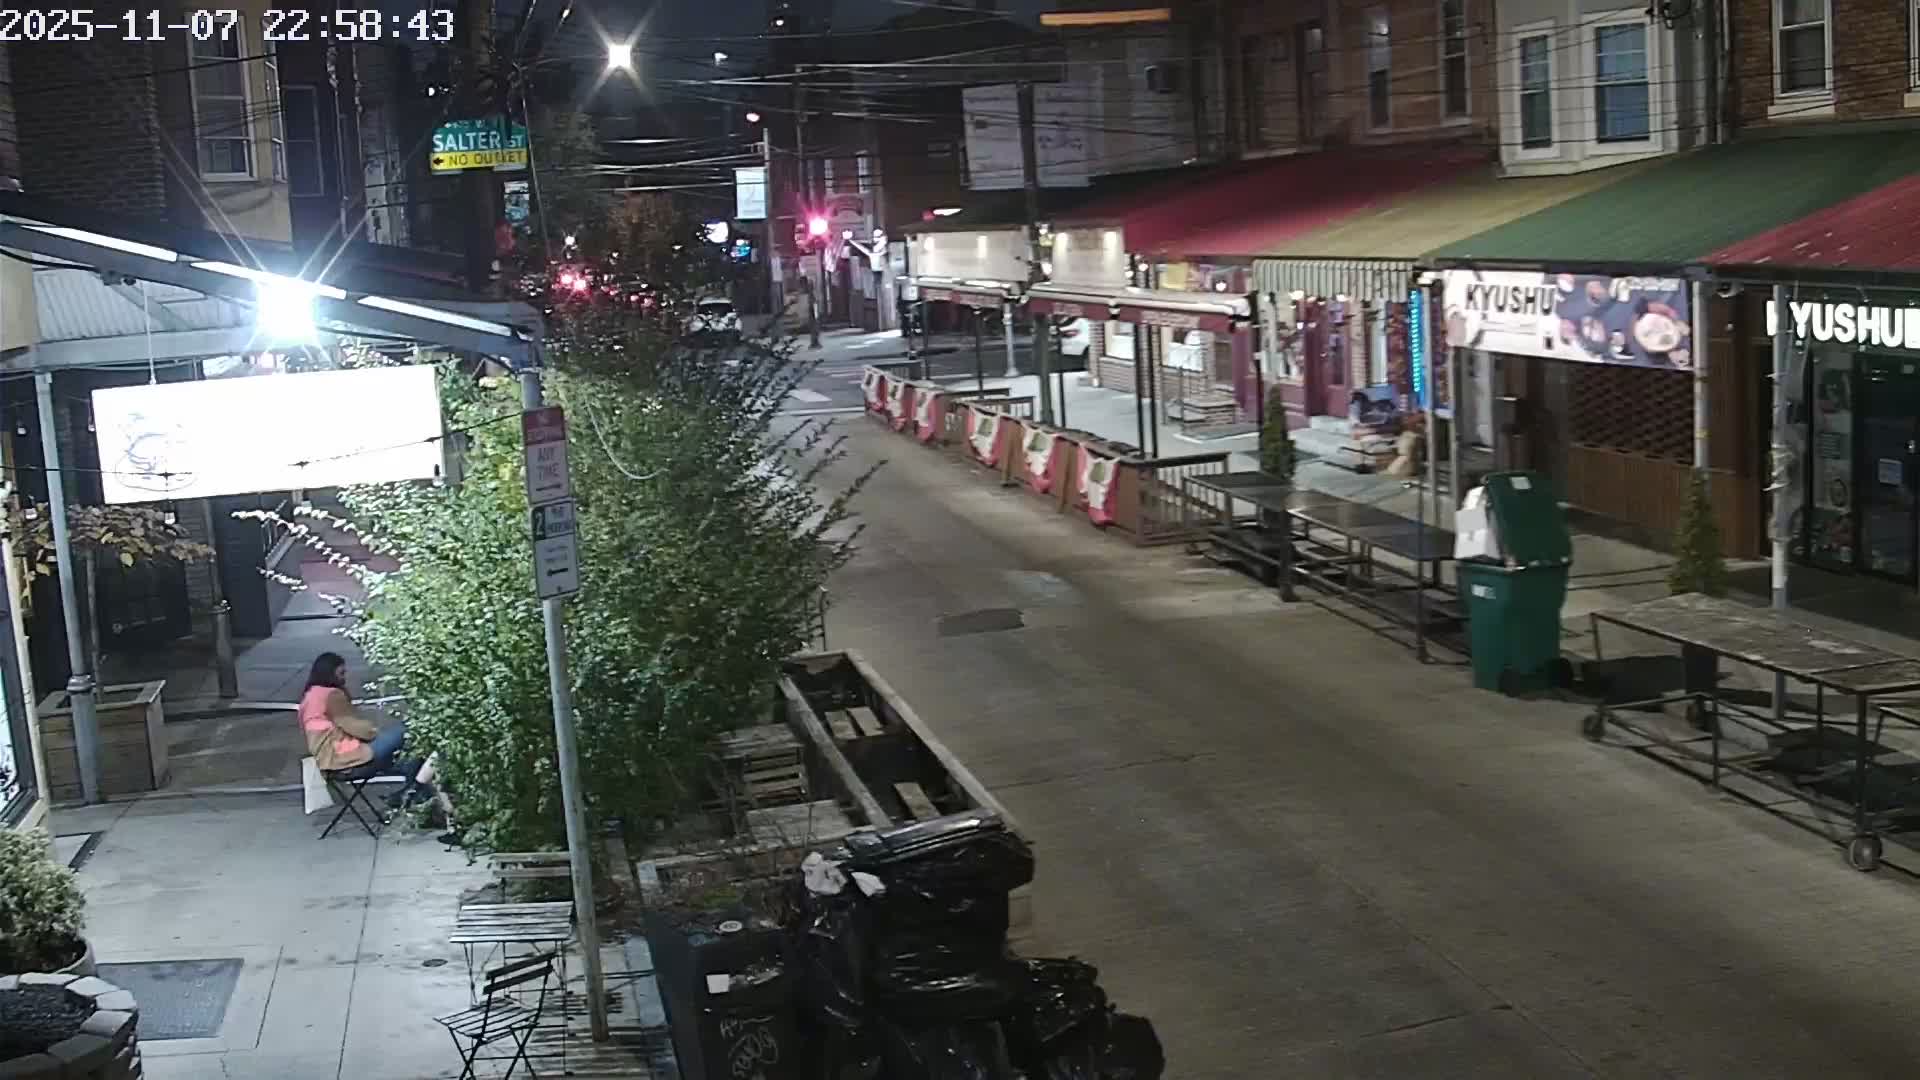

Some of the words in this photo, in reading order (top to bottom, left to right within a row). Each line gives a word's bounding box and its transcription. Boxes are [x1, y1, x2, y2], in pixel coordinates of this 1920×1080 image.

[432, 131, 501, 152] SALTER
[508, 134, 524, 148] ST
[448, 153, 468, 167] NO
[1465, 283, 1558, 316] KYUSHU
